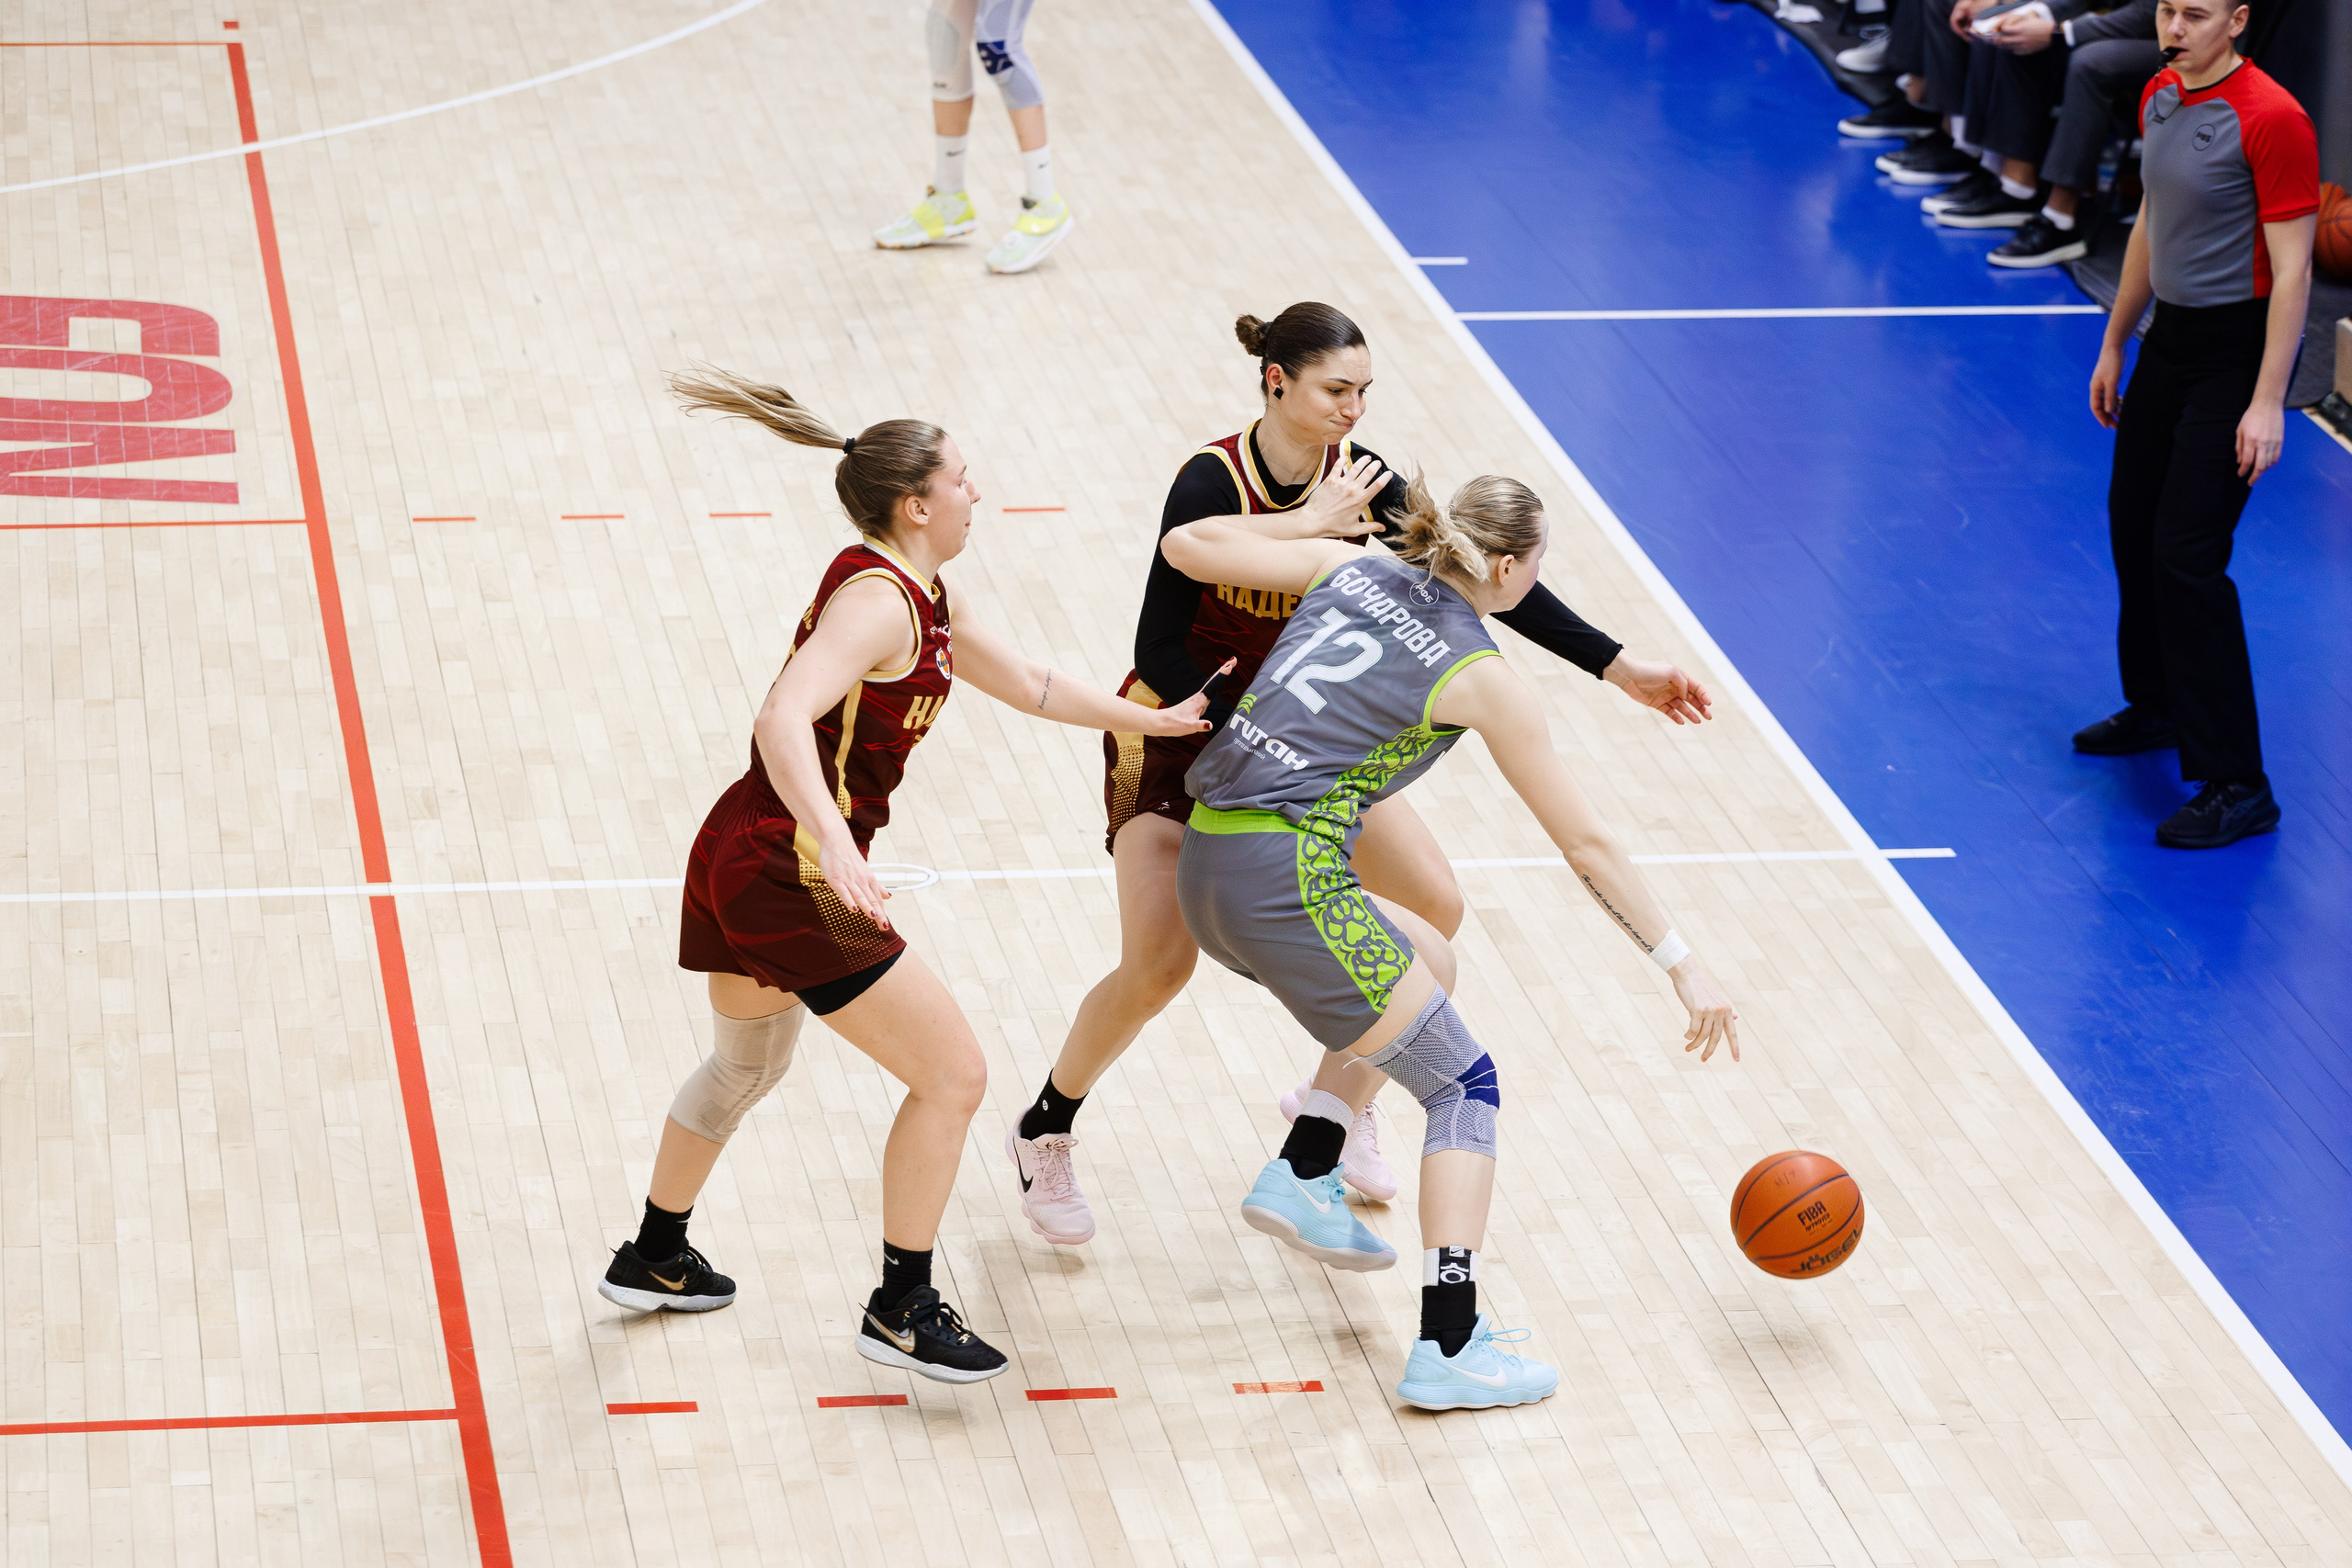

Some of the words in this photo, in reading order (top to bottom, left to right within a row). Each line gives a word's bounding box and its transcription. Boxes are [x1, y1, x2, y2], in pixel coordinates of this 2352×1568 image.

[1270, 606, 1384, 715] 12
[1329, 566, 1452, 669] БОЧАРОВА
[1797, 1200, 1826, 1226] FIBA
